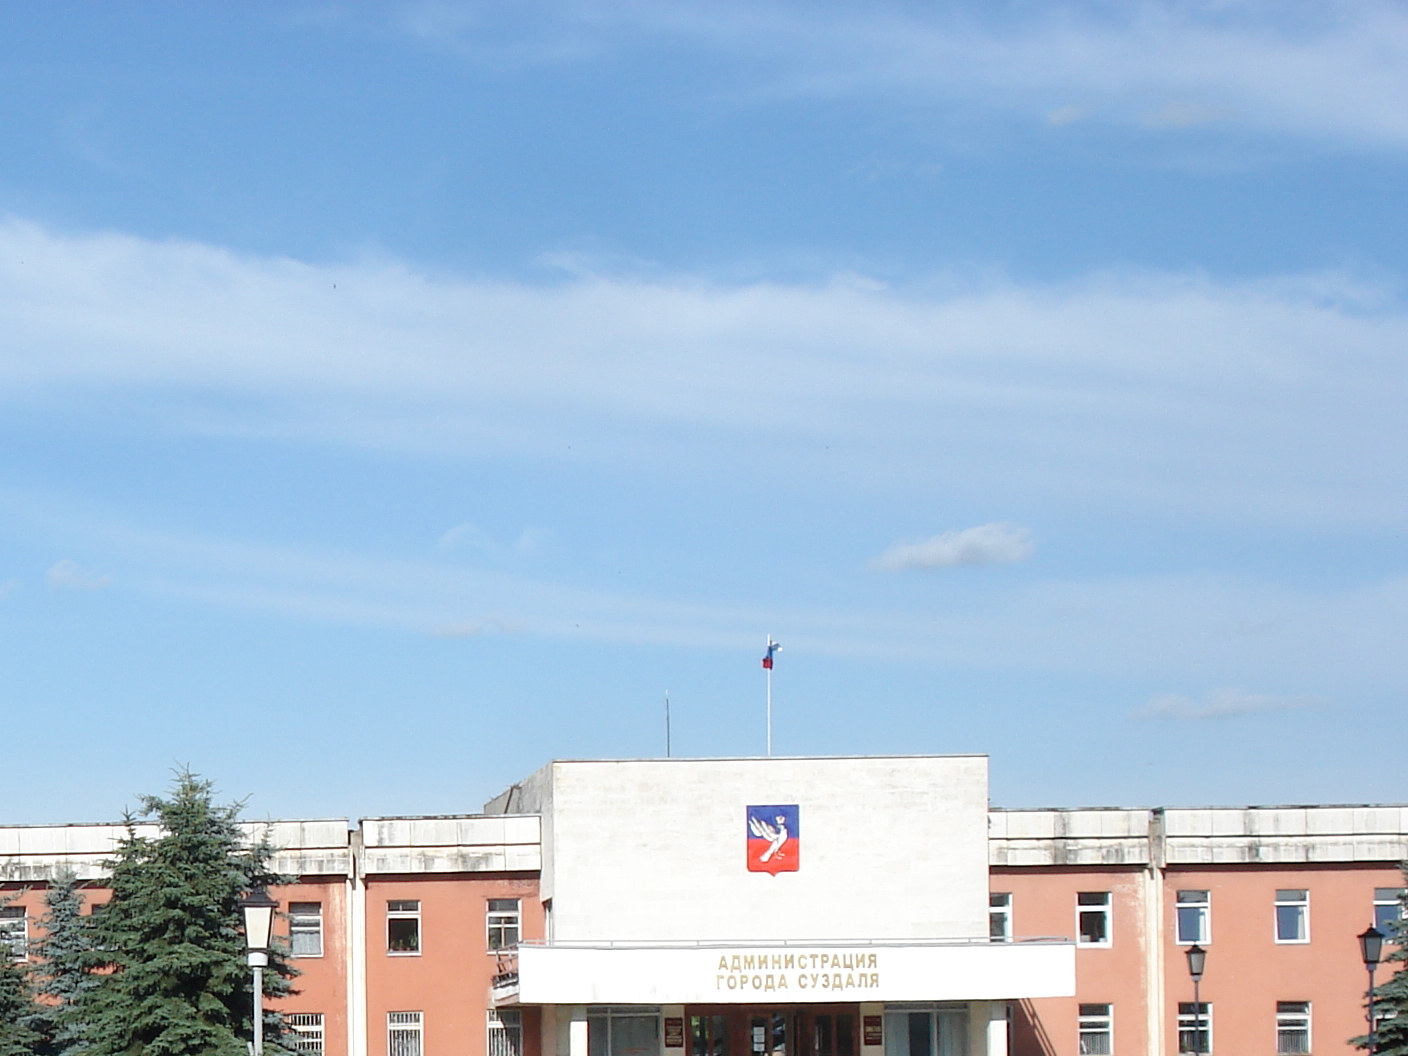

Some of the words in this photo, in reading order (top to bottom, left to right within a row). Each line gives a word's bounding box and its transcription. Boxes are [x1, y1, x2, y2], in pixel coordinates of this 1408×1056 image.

[718, 953, 878, 973] АДМИНИСТРАЦИЯ
[716, 974, 789, 992] ГОРОДА
[798, 973, 880, 991] СУЗДАЛЯ
